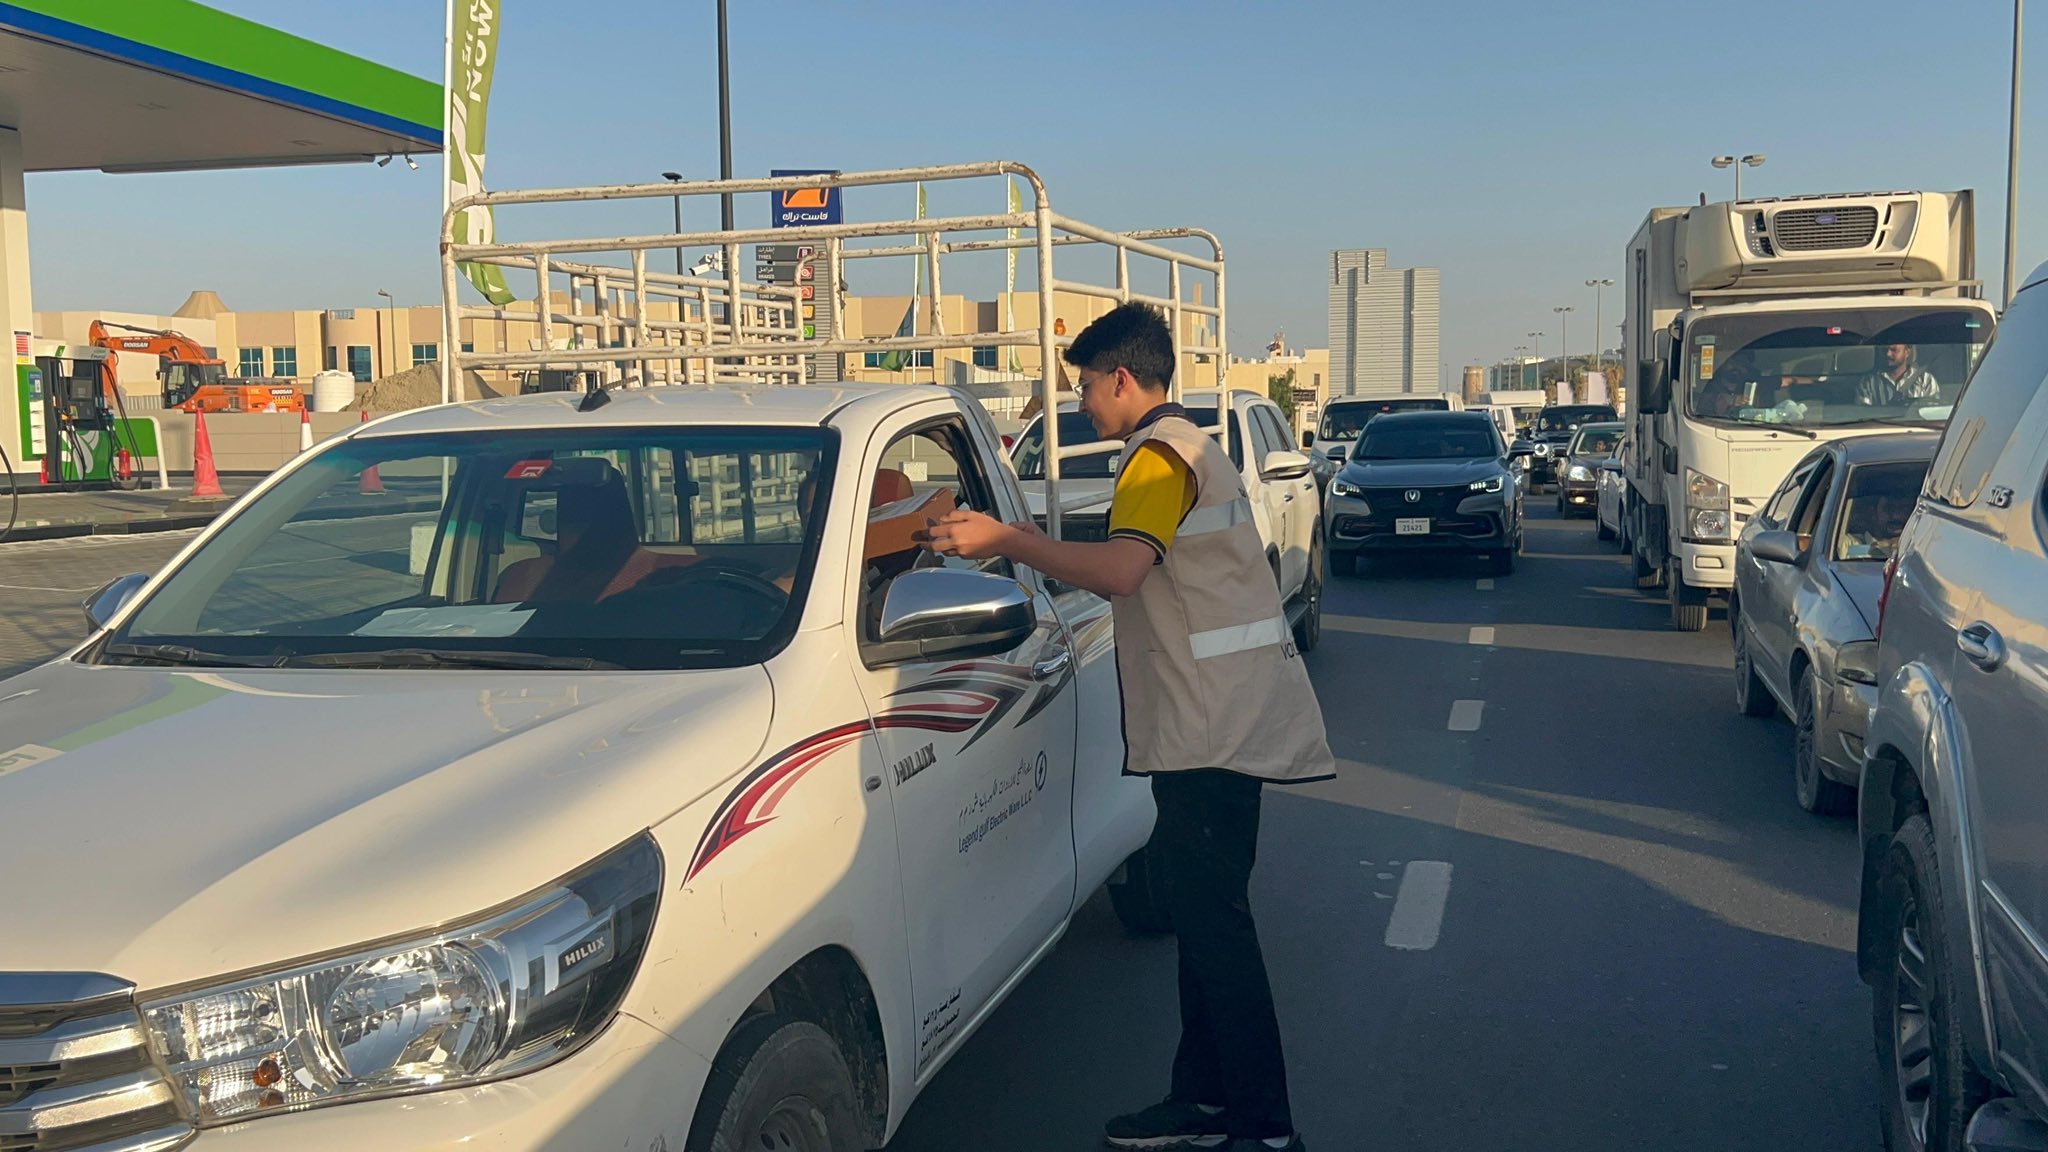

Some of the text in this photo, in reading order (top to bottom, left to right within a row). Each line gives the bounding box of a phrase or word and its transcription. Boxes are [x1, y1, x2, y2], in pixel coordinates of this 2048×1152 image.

[469, 0, 493, 102] NOW
[893, 743, 938, 787] HILUX
[959, 824, 979, 854] Legend
[989, 807, 1009, 832] Electric
[564, 936, 605, 967] HILUX
